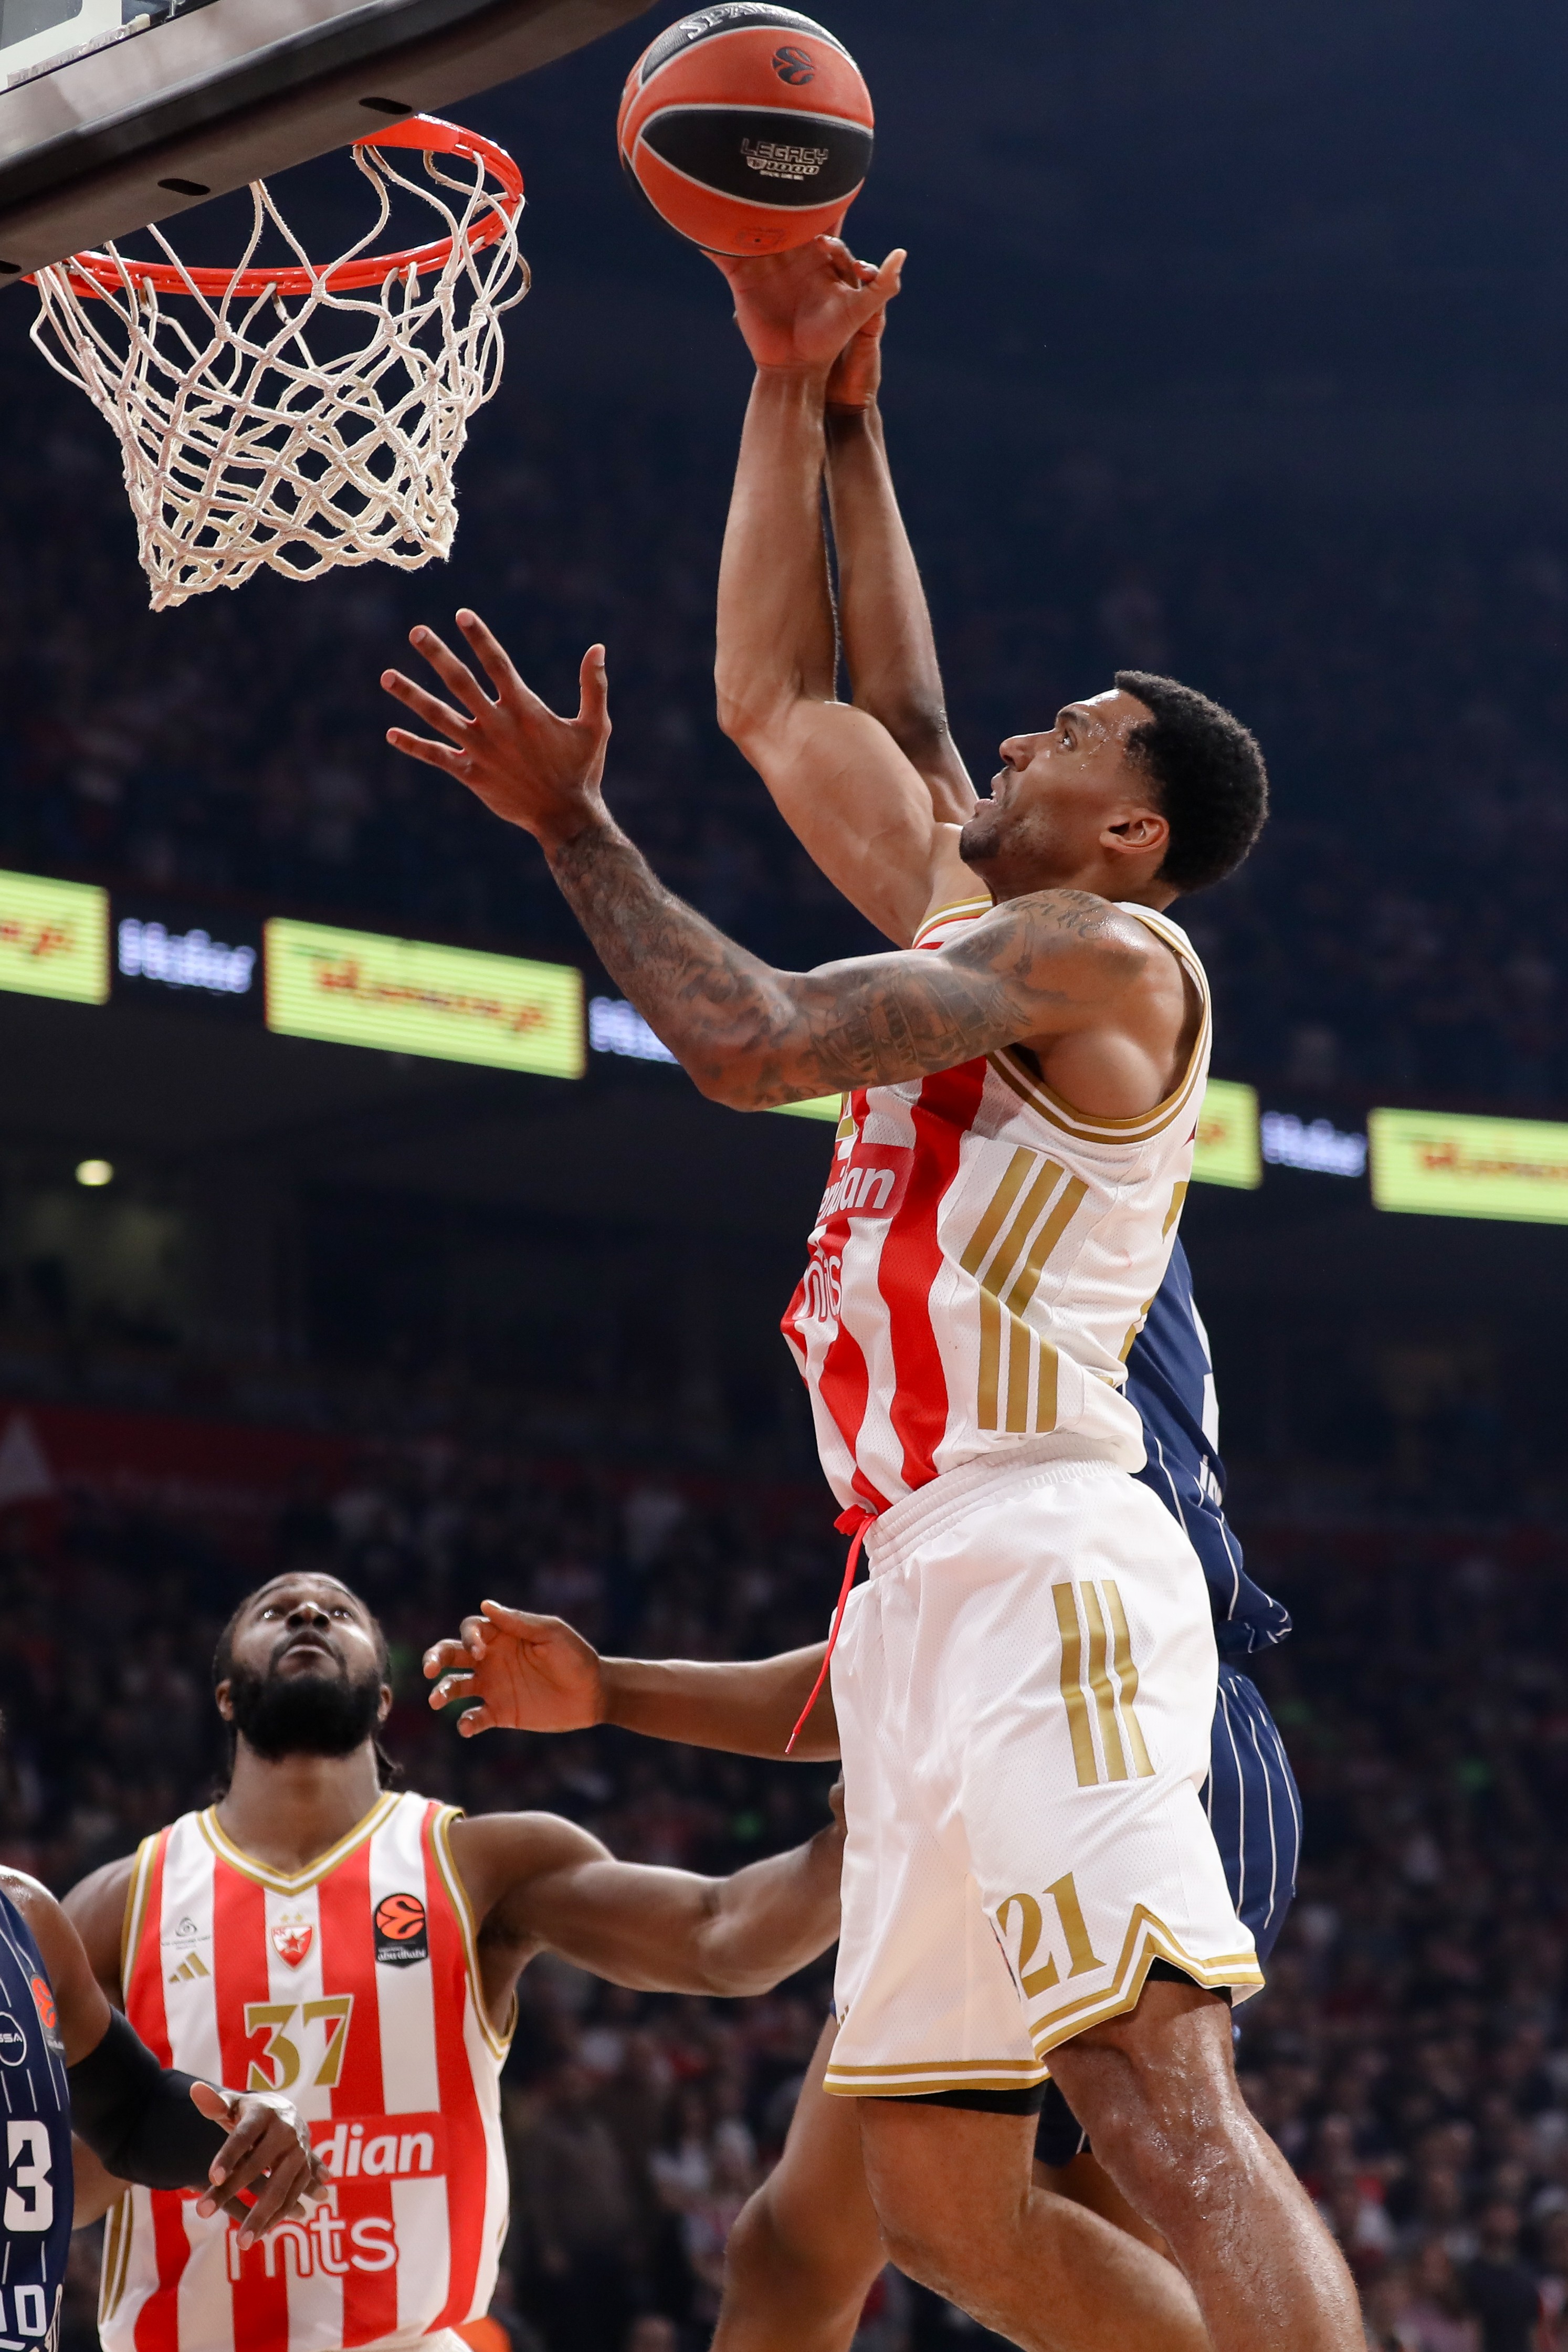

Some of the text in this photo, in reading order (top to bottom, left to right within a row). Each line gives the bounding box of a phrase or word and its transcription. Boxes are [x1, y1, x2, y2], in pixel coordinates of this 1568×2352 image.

[741, 138, 829, 165] LEGACY
[996, 1872, 1107, 2000] 21
[244, 1993, 355, 2092] 37
[229, 2206, 397, 2281] mts
